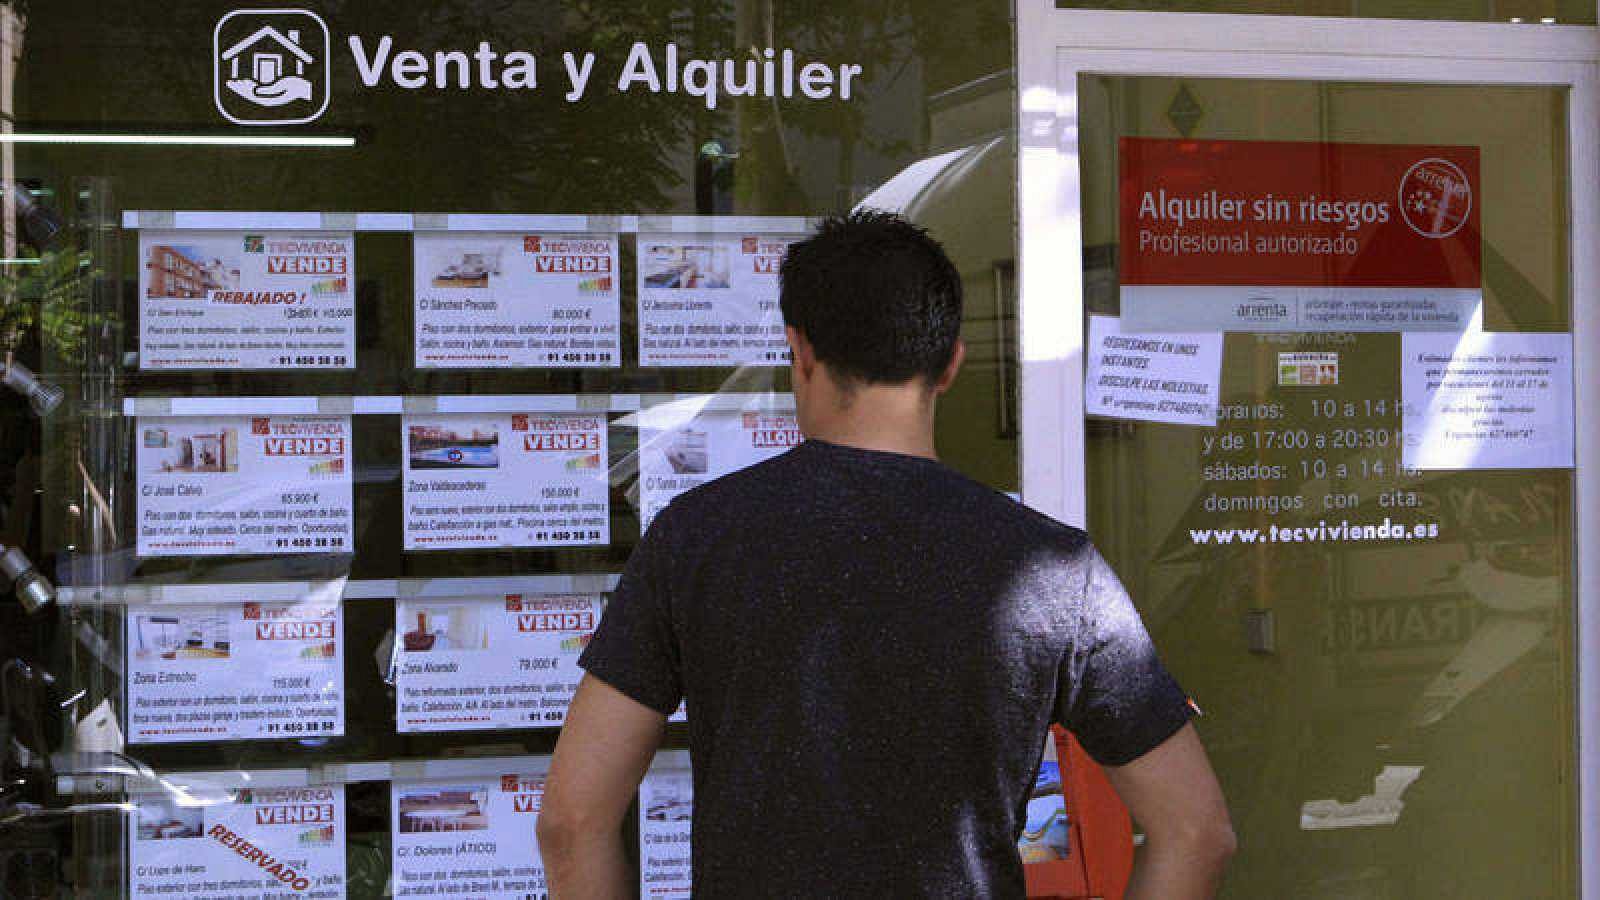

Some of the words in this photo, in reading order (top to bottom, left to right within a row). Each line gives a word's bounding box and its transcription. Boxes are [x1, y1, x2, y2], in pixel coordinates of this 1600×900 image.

[348, 34, 537, 90] Venta
[562, 52, 595, 103] y
[617, 41, 863, 110] Alquiler
[1139, 189, 1247, 228] Alquiler
[1253, 193, 1290, 222] sin
[1300, 197, 1390, 231] riesgos
[1139, 230, 1249, 257] Profesional
[1255, 231, 1358, 256] autorizado
[269, 256, 346, 274] VENDE
[537, 256, 611, 273] VENDE
[211, 290, 297, 305] REBAJADO
[547, 353, 559, 362] 91
[1215, 401, 1285, 420] orarios:
[1310, 400, 1337, 418] 10
[1343, 404, 1357, 417] a
[1364, 400, 1386, 416] 14
[265, 438, 345, 456] VENDE
[526, 434, 601, 451] VENDE
[1202, 437, 1215, 456] y
[1220, 432, 1245, 450] de
[1251, 431, 1309, 449] 17:00
[1315, 435, 1327, 449] a
[1333, 429, 1389, 449] 20:30
[1203, 463, 1288, 481] sábados:
[1300, 459, 1327, 479] 10
[1336, 463, 1347, 478] a
[1361, 459, 1385, 478] 14
[1204, 492, 1304, 515] domingos
[1323, 492, 1359, 509] con
[1378, 487, 1424, 508] cita.
[536, 532, 548, 541] 91
[1189, 517, 1439, 545] www.tecvivienda.es
[275, 538, 289, 547] 91
[257, 622, 335, 640] VENDE
[519, 613, 594, 632] VENDE
[256, 804, 335, 824] VENDE
[208, 823, 309, 891] RESERVADO
